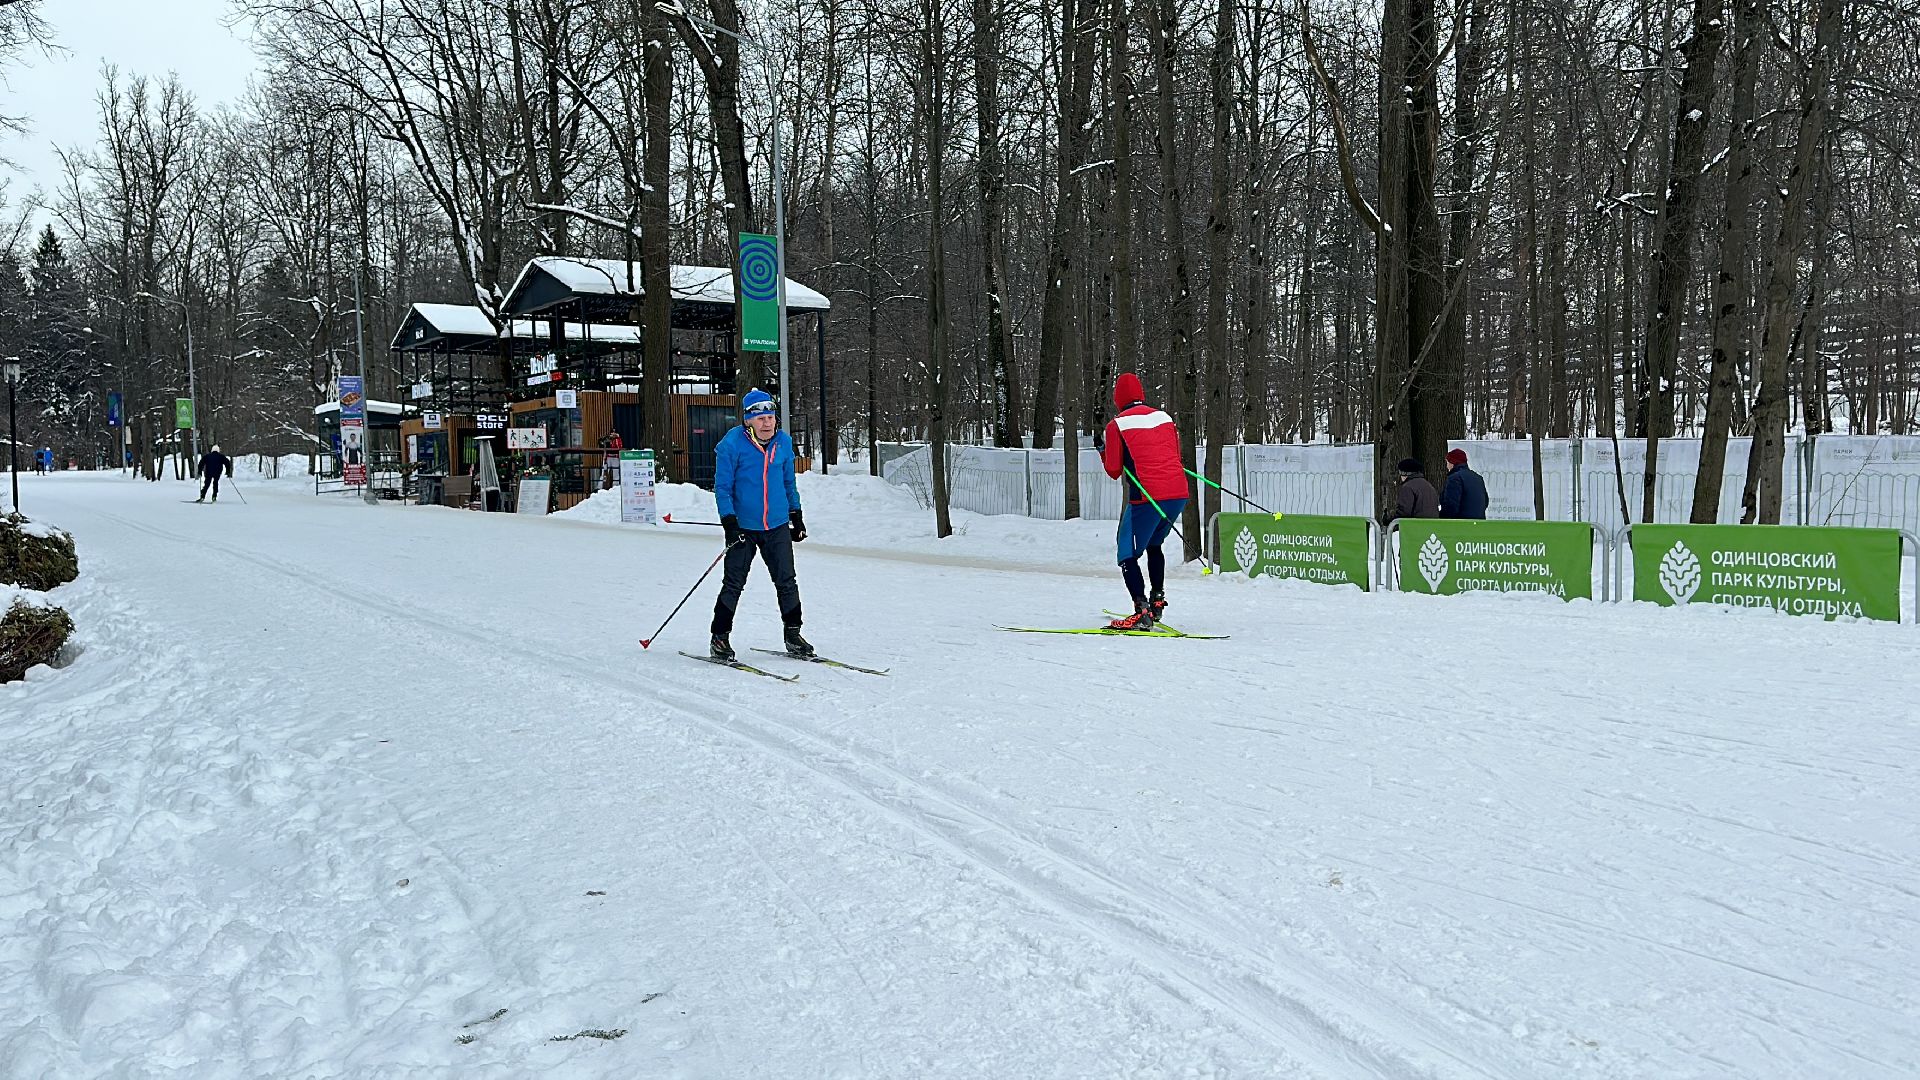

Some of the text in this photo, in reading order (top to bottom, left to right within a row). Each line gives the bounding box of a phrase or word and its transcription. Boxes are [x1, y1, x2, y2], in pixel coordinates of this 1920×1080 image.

[476, 421, 503, 429] store
[1262, 533, 1333, 548] ОДИНЦОВСКИЙ
[1455, 541, 1546, 557] ОДИНЦОВСКИЙ
[1263, 549, 1338, 566] ПАРК КУЛЬТУРЫ,
[1711, 550, 1836, 569] ОДИНЦОВСКИЙ
[1263, 565, 1347, 581] СПОРТА И ОТДЫХА
[1455, 560, 1553, 578] ПАРК КУЛЬТУРЫ,
[1456, 577, 1566, 597] СПОРТА И ОТДЫХА
[1711, 572, 1847, 595] ПАРК КУЛЬТУРЫ,
[1711, 593, 1863, 616] СПОРТА И ОТДЫХА
